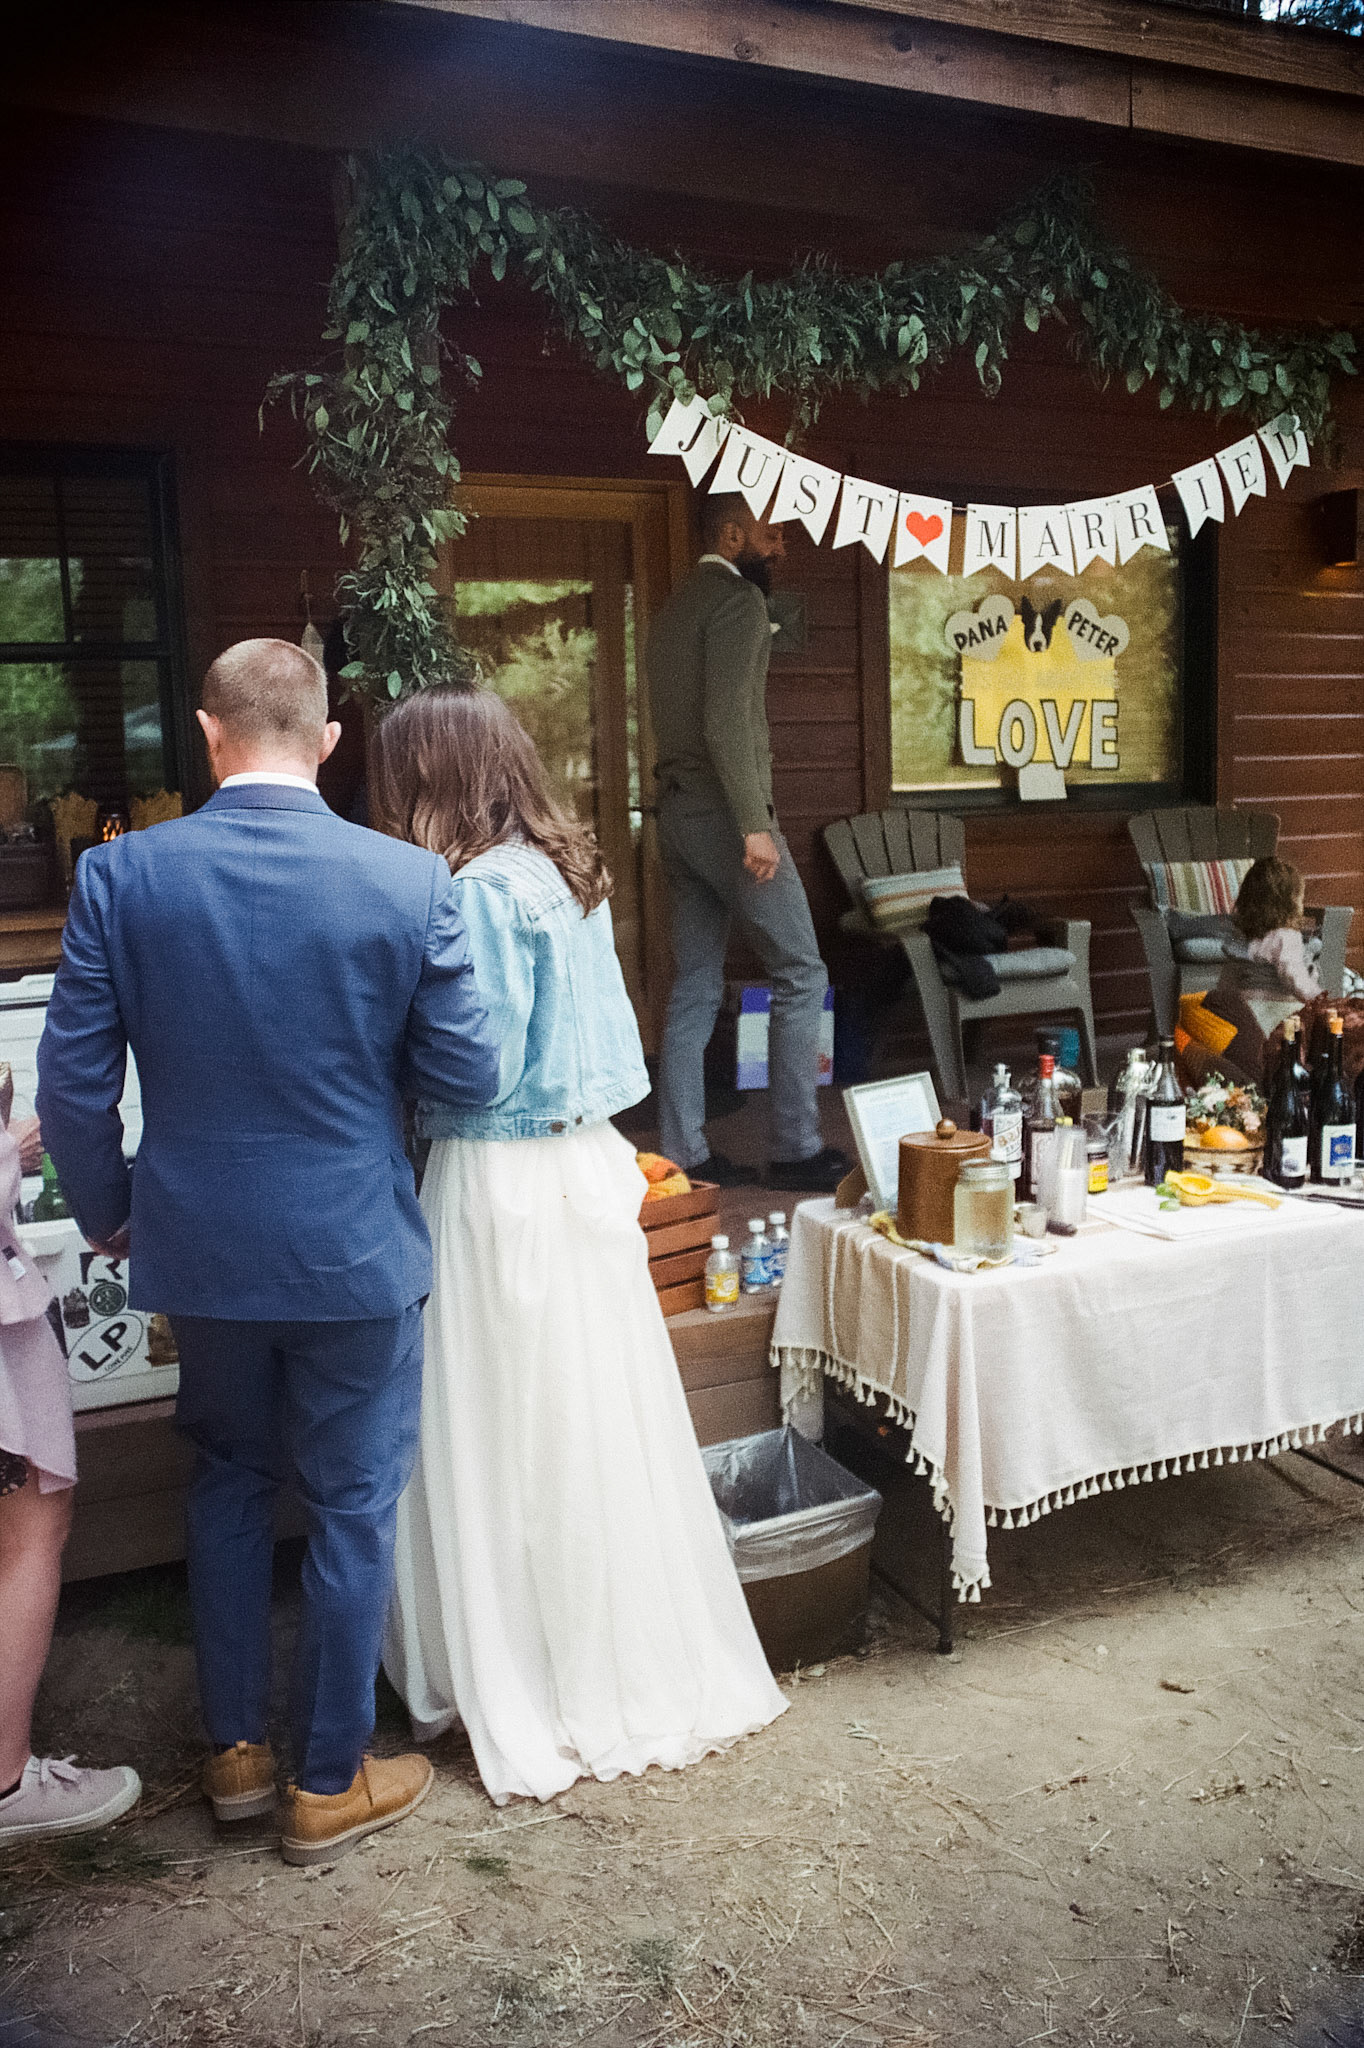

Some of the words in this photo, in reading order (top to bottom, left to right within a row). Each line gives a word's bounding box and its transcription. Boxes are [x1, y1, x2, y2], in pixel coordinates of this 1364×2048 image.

[678, 411, 883, 536] JUST
[976, 430, 1300, 558] MARRIED
[953, 615, 1008, 651] DANA
[1067, 611, 1119, 656] PETER
[959, 698, 1120, 770] LOVE
[78, 1321, 127, 1371] LP
